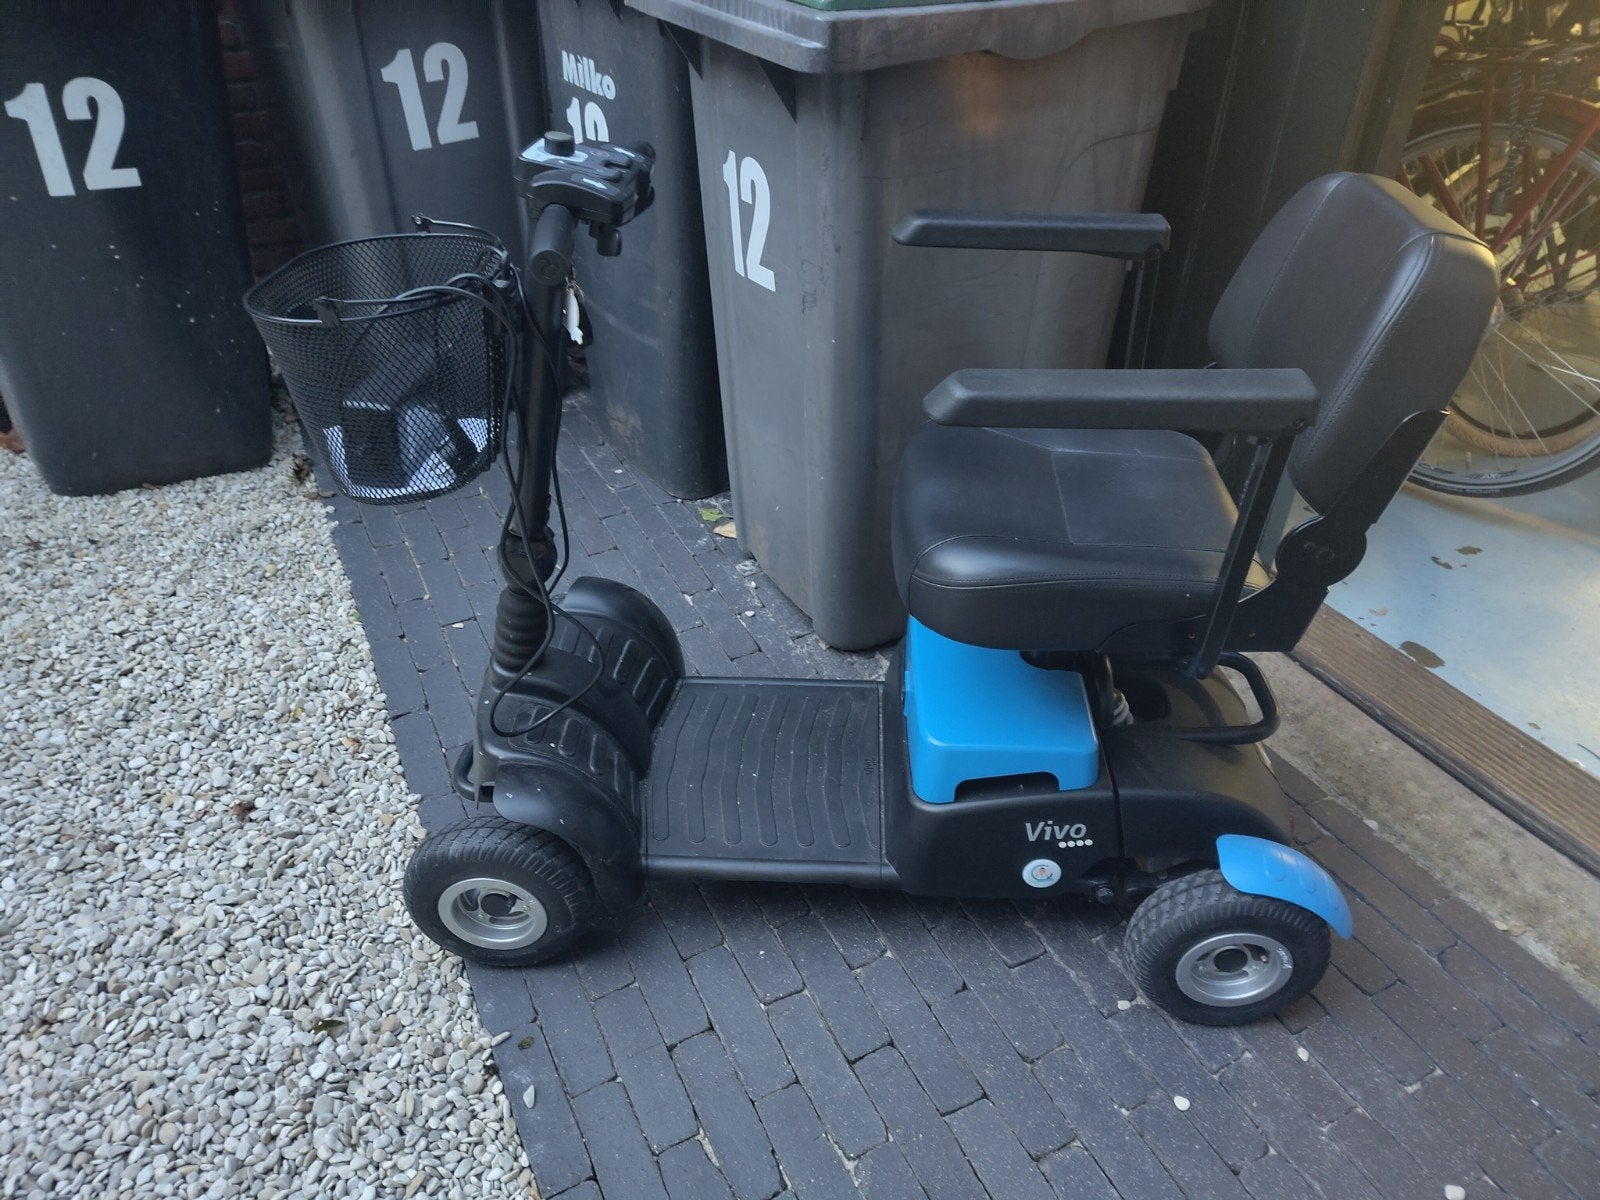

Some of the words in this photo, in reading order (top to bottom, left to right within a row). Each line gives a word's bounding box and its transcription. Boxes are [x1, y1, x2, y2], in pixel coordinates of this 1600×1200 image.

[378, 42, 479, 151] 12
[561, 50, 616, 100] Milko
[4, 76, 141, 197] 12
[722, 149, 777, 292] 12
[1025, 820, 1087, 842] Vivo
